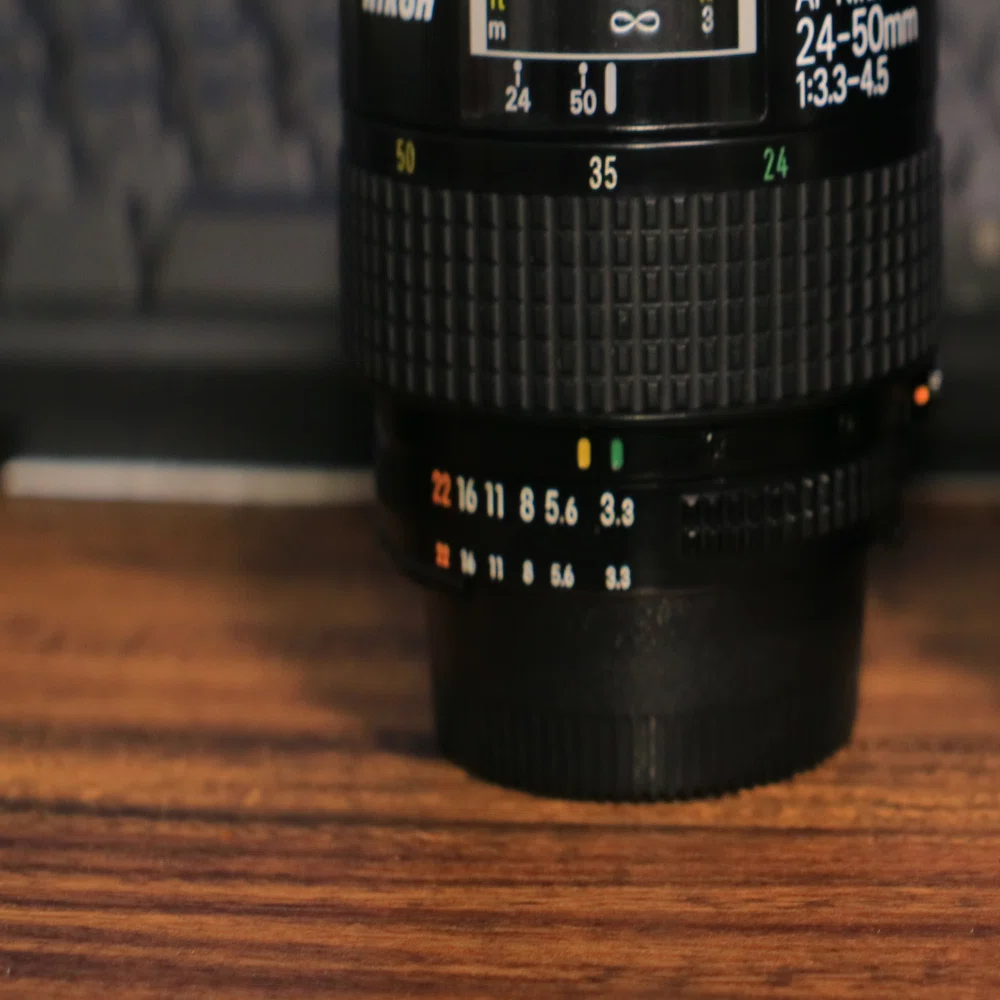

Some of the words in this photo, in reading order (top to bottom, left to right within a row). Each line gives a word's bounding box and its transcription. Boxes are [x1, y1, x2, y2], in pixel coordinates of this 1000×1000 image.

[488, 20, 506, 40] m
[701, 5, 714, 34] 3
[796, 3, 919, 67] 24-50mm
[505, 86, 532, 114] 24
[570, 88, 597, 116] 50
[795, 54, 890, 109] 1:3.3-4.5
[395, 140, 416, 175] 50
[589, 155, 618, 190] 35
[763, 146, 789, 182] 24
[431, 468, 452, 509] 22
[456, 475, 478, 514] 16
[484, 480, 505, 520] 11
[519, 486, 536, 524] 8
[544, 488, 579, 526] 5.6
[600, 492, 635, 528] 3.3
[488, 553, 505, 582] 11
[550, 562, 576, 590] 5.6
[605, 564, 632, 591] 3.3
